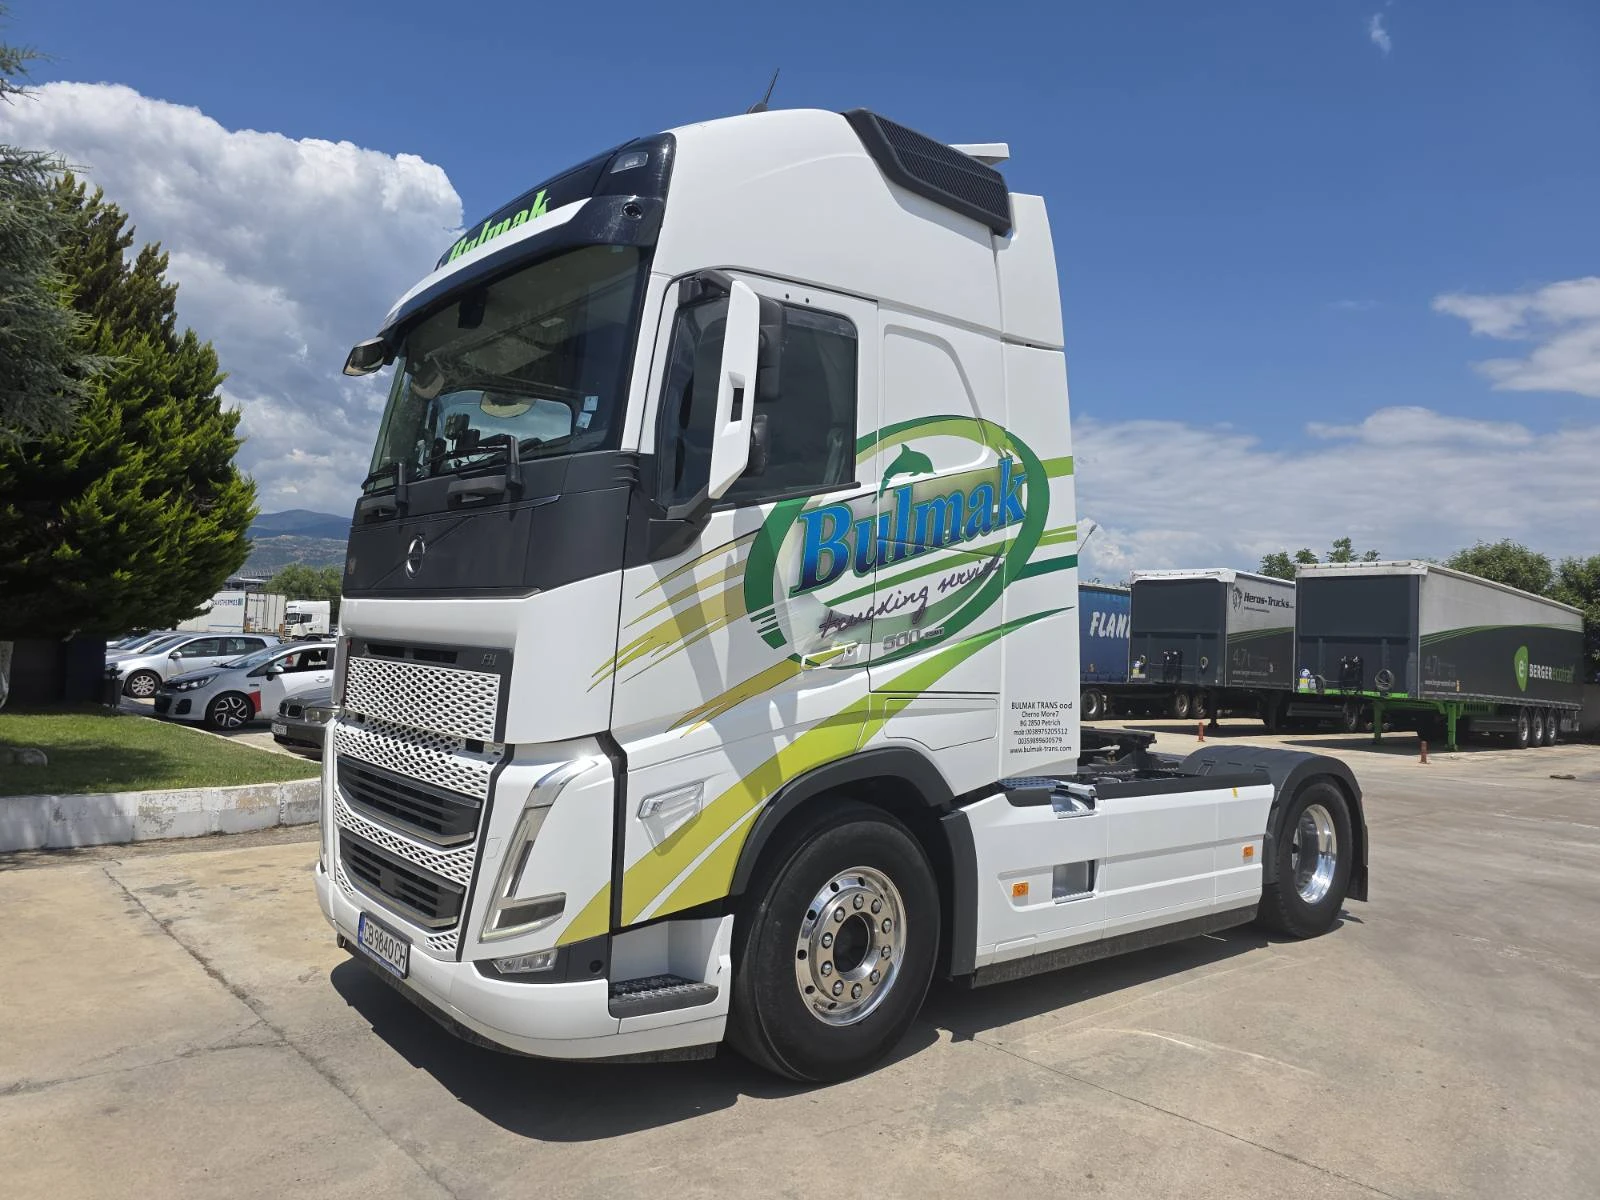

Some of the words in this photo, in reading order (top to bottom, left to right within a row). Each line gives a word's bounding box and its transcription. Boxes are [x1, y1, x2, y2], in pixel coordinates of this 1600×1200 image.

[789, 454, 1029, 598] Bulmak
[1011, 701, 1036, 710] BULMAK
[1036, 701, 1058, 709] TRANS
